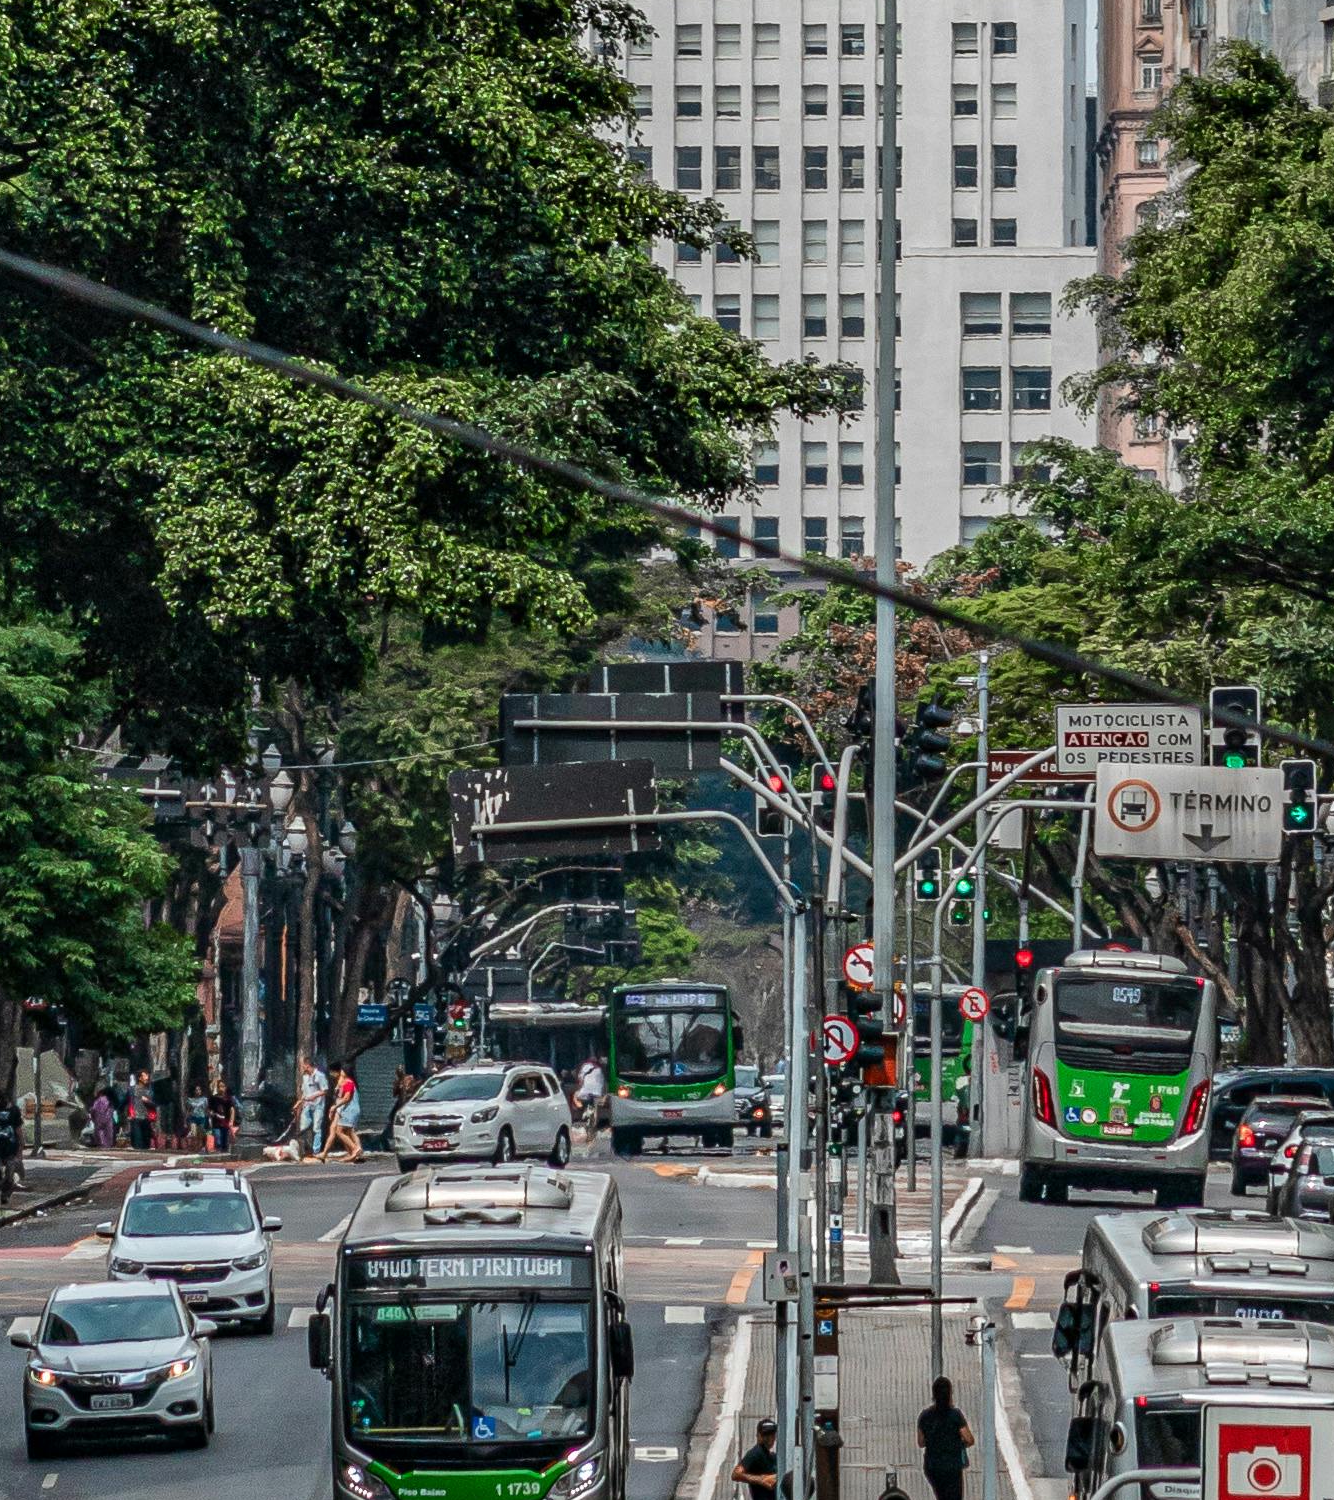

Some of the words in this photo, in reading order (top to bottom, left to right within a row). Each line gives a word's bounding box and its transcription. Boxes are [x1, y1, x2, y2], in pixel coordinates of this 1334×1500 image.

[1068, 713, 1189, 728] MOTOCICLISTA
[1067, 732, 1149, 747] ATENÇÃO
[1157, 734, 1192, 746] COM
[1066, 753, 1087, 765] OS
[1097, 752, 1195, 764] PEDESTRES
[1169, 790, 1272, 813] TÉRMINO
[507, 1482, 540, 1496] 1739
